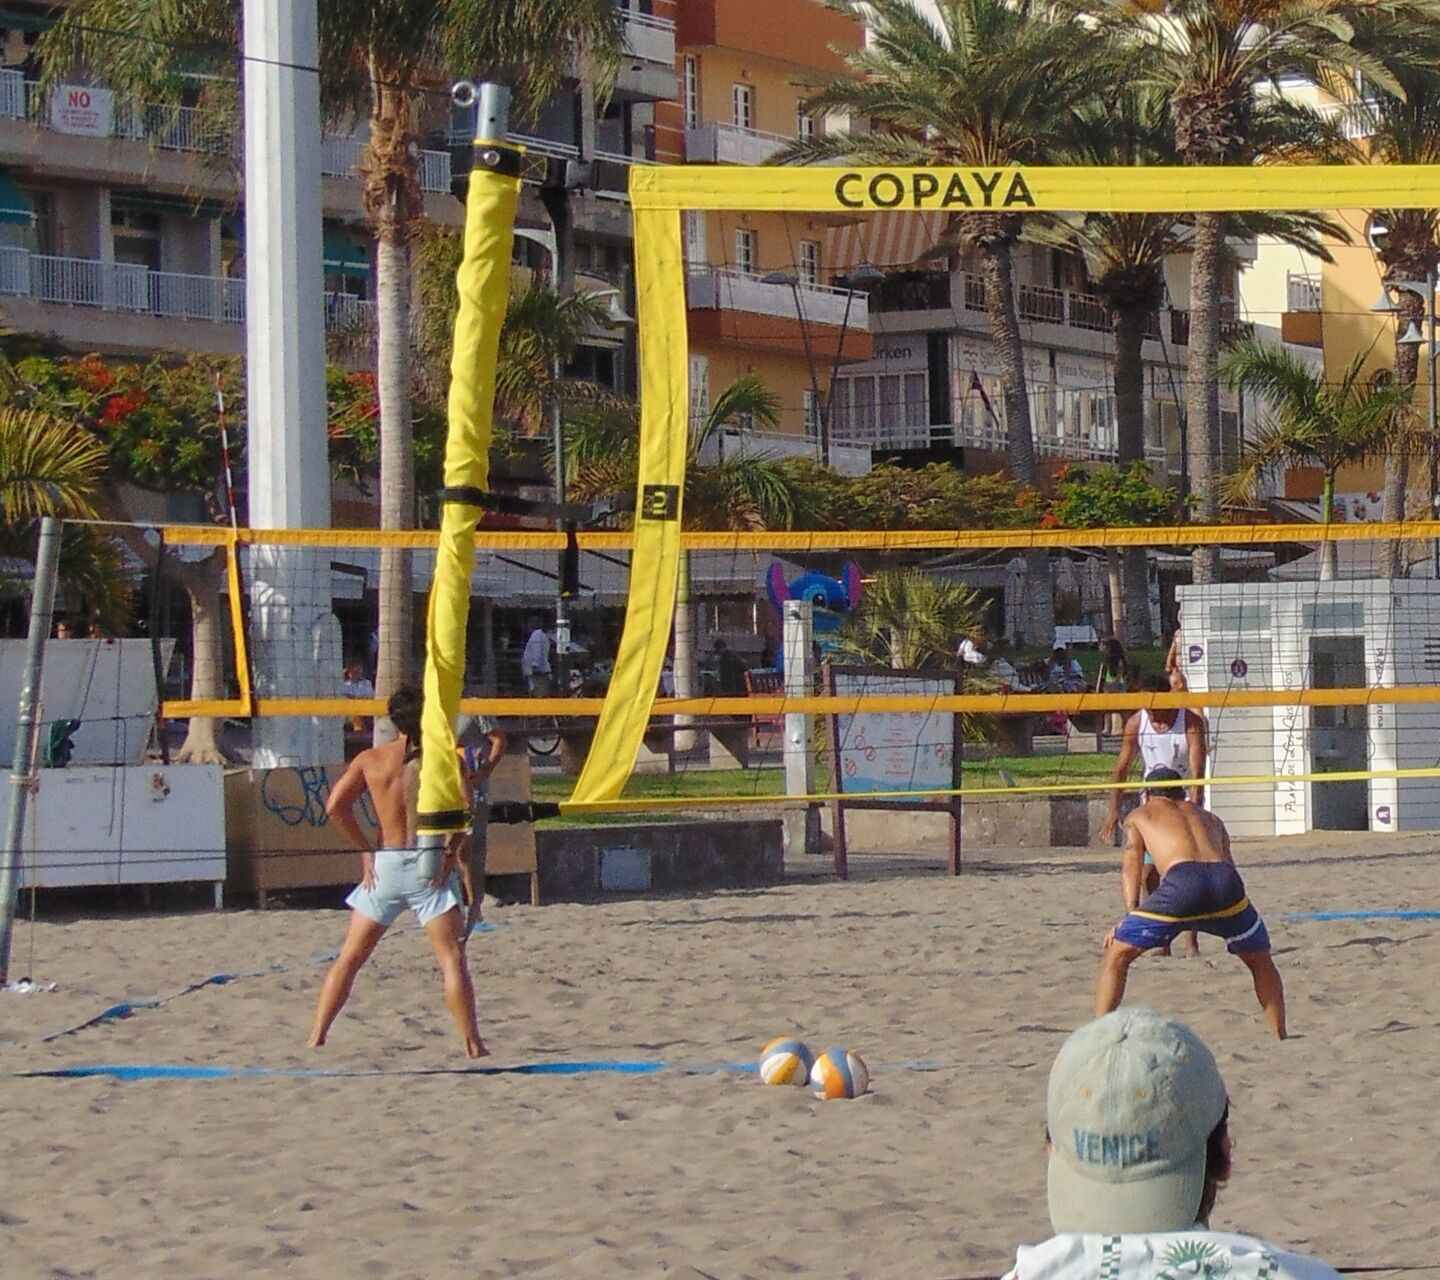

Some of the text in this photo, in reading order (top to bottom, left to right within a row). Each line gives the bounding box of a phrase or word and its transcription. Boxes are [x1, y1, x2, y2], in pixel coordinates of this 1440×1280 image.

[68, 91, 91, 108] NO
[835, 171, 1036, 208] COPAYA
[1073, 1128, 1161, 1167] VENICE
